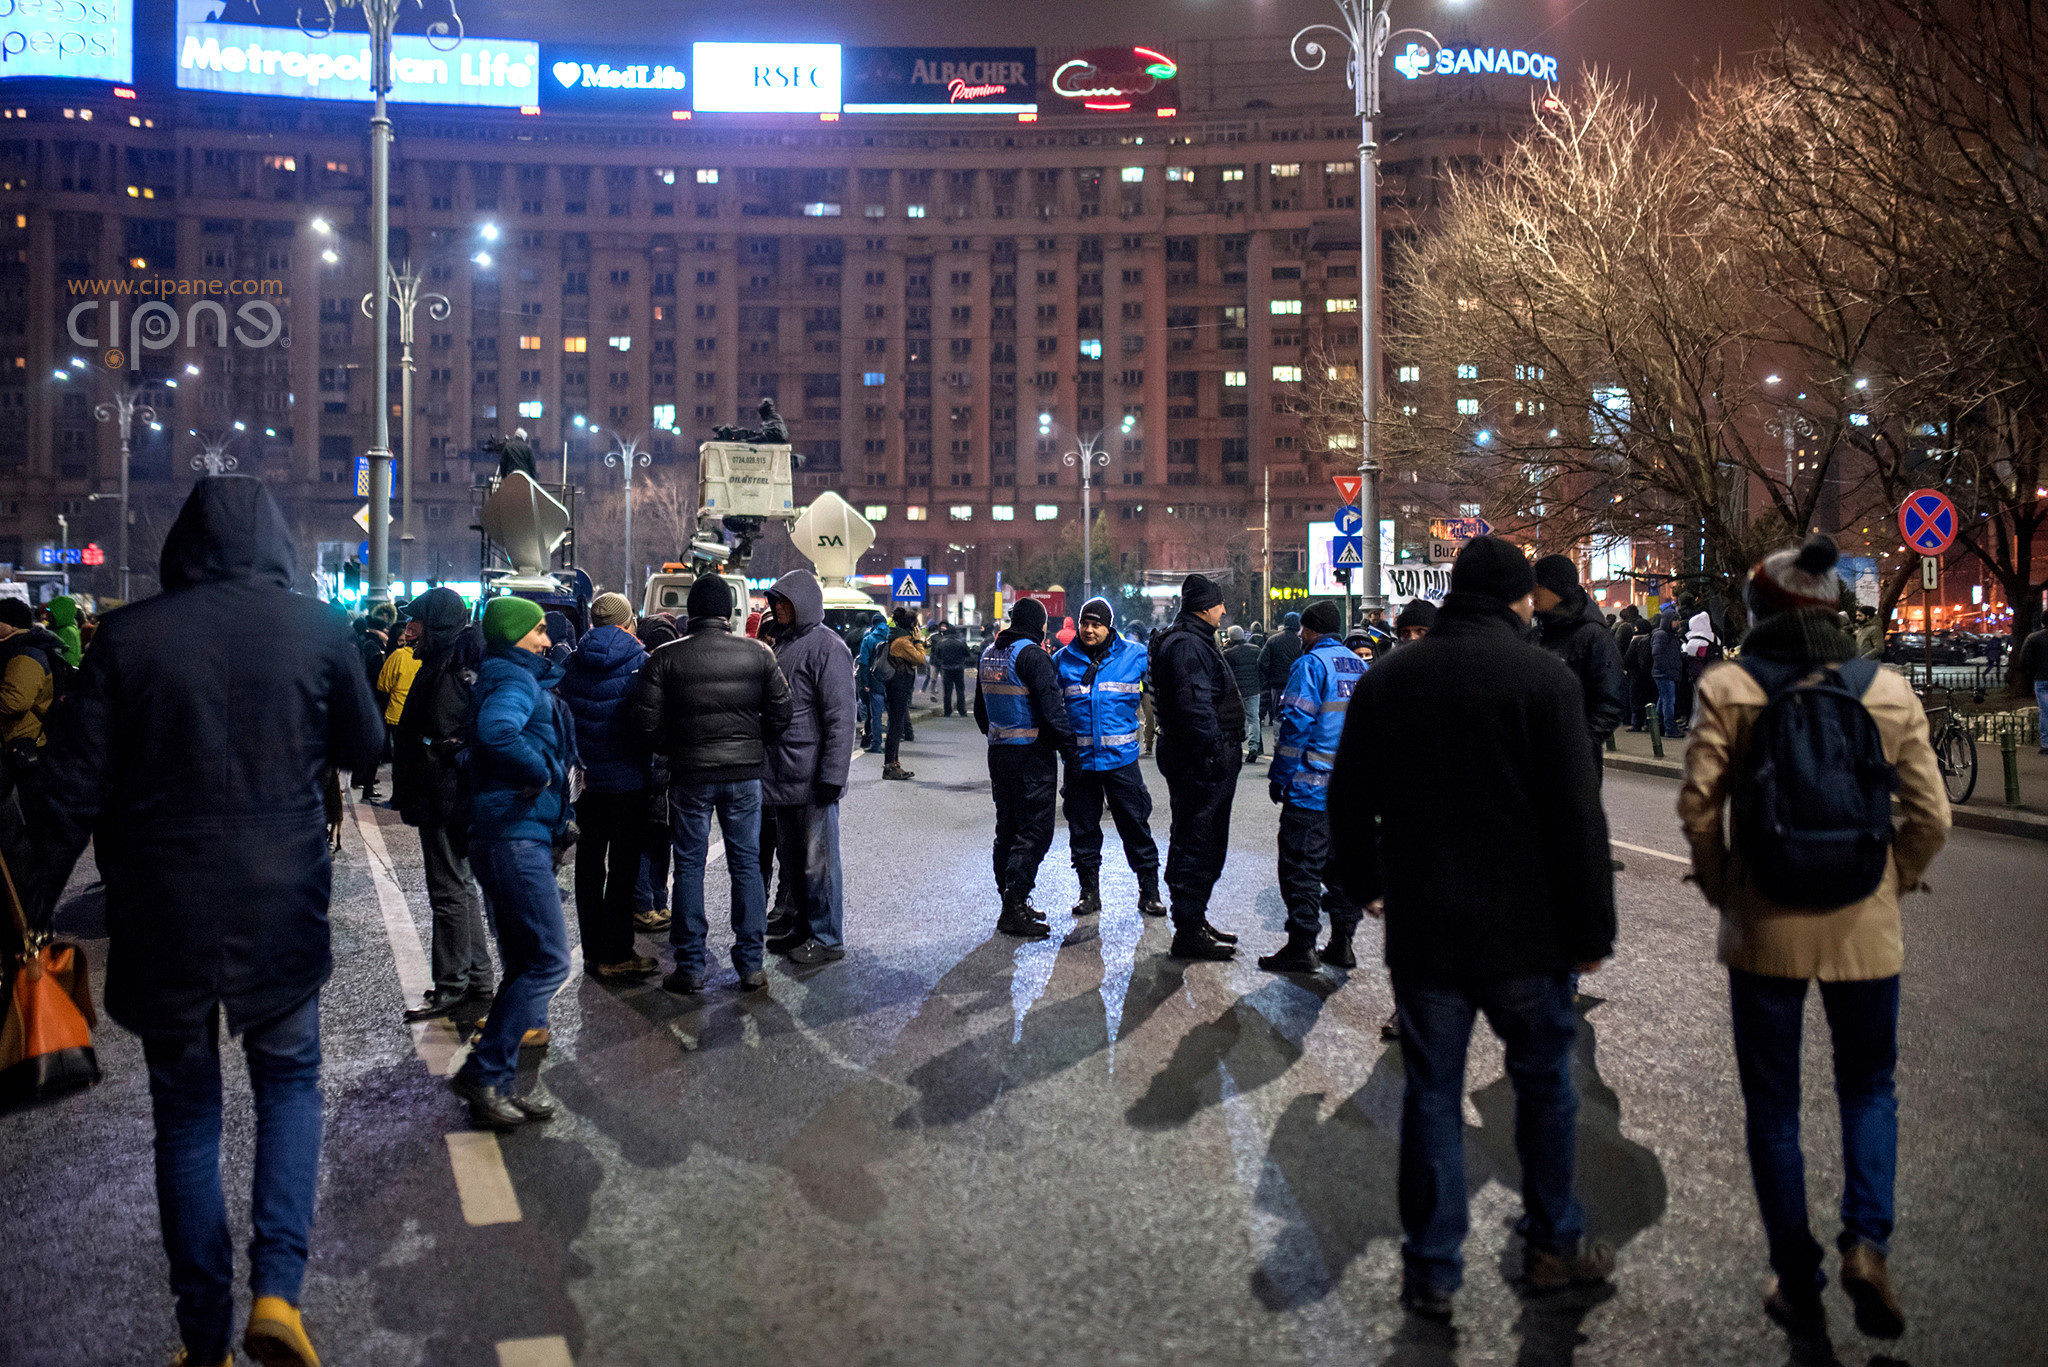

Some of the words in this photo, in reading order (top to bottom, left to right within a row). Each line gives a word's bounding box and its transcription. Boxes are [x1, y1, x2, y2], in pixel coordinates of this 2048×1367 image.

[3, 29, 117, 62] pepsi
[460, 50, 532, 88] Life
[581, 63, 686, 90] MedLife
[911, 58, 1028, 86] ALBACHER
[1436, 47, 1558, 82] SANADOR
[948, 77, 1007, 104] Premium
